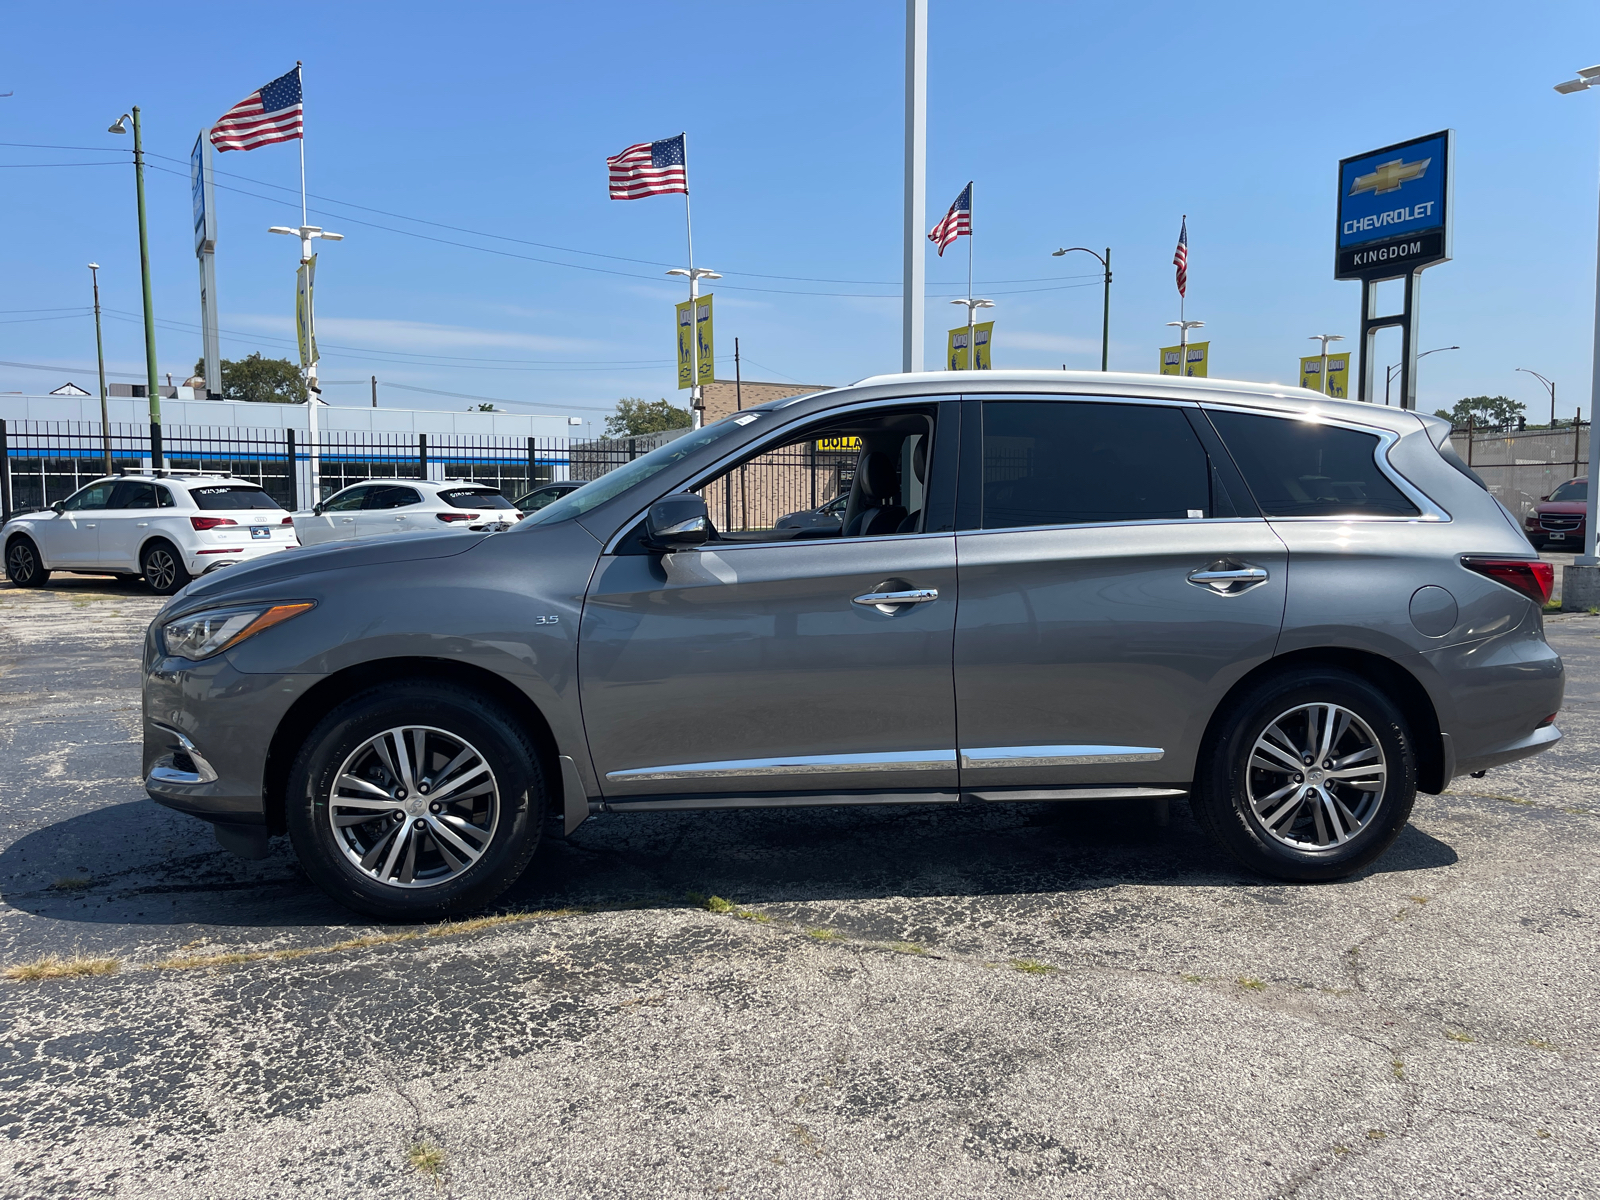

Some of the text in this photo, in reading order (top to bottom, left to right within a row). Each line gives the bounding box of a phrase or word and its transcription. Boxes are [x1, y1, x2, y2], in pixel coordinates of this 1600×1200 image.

[1343, 201, 1434, 235] CHEVROLET
[1353, 241, 1421, 266] KINGDOM
[952, 333, 968, 348] King
[1165, 351, 1180, 364] King
[1187, 349, 1203, 361] dom
[1305, 360, 1320, 373] King
[1328, 359, 1344, 371] dom
[822, 437, 862, 448] DOLLA
[535, 615, 559, 625] 3.5
